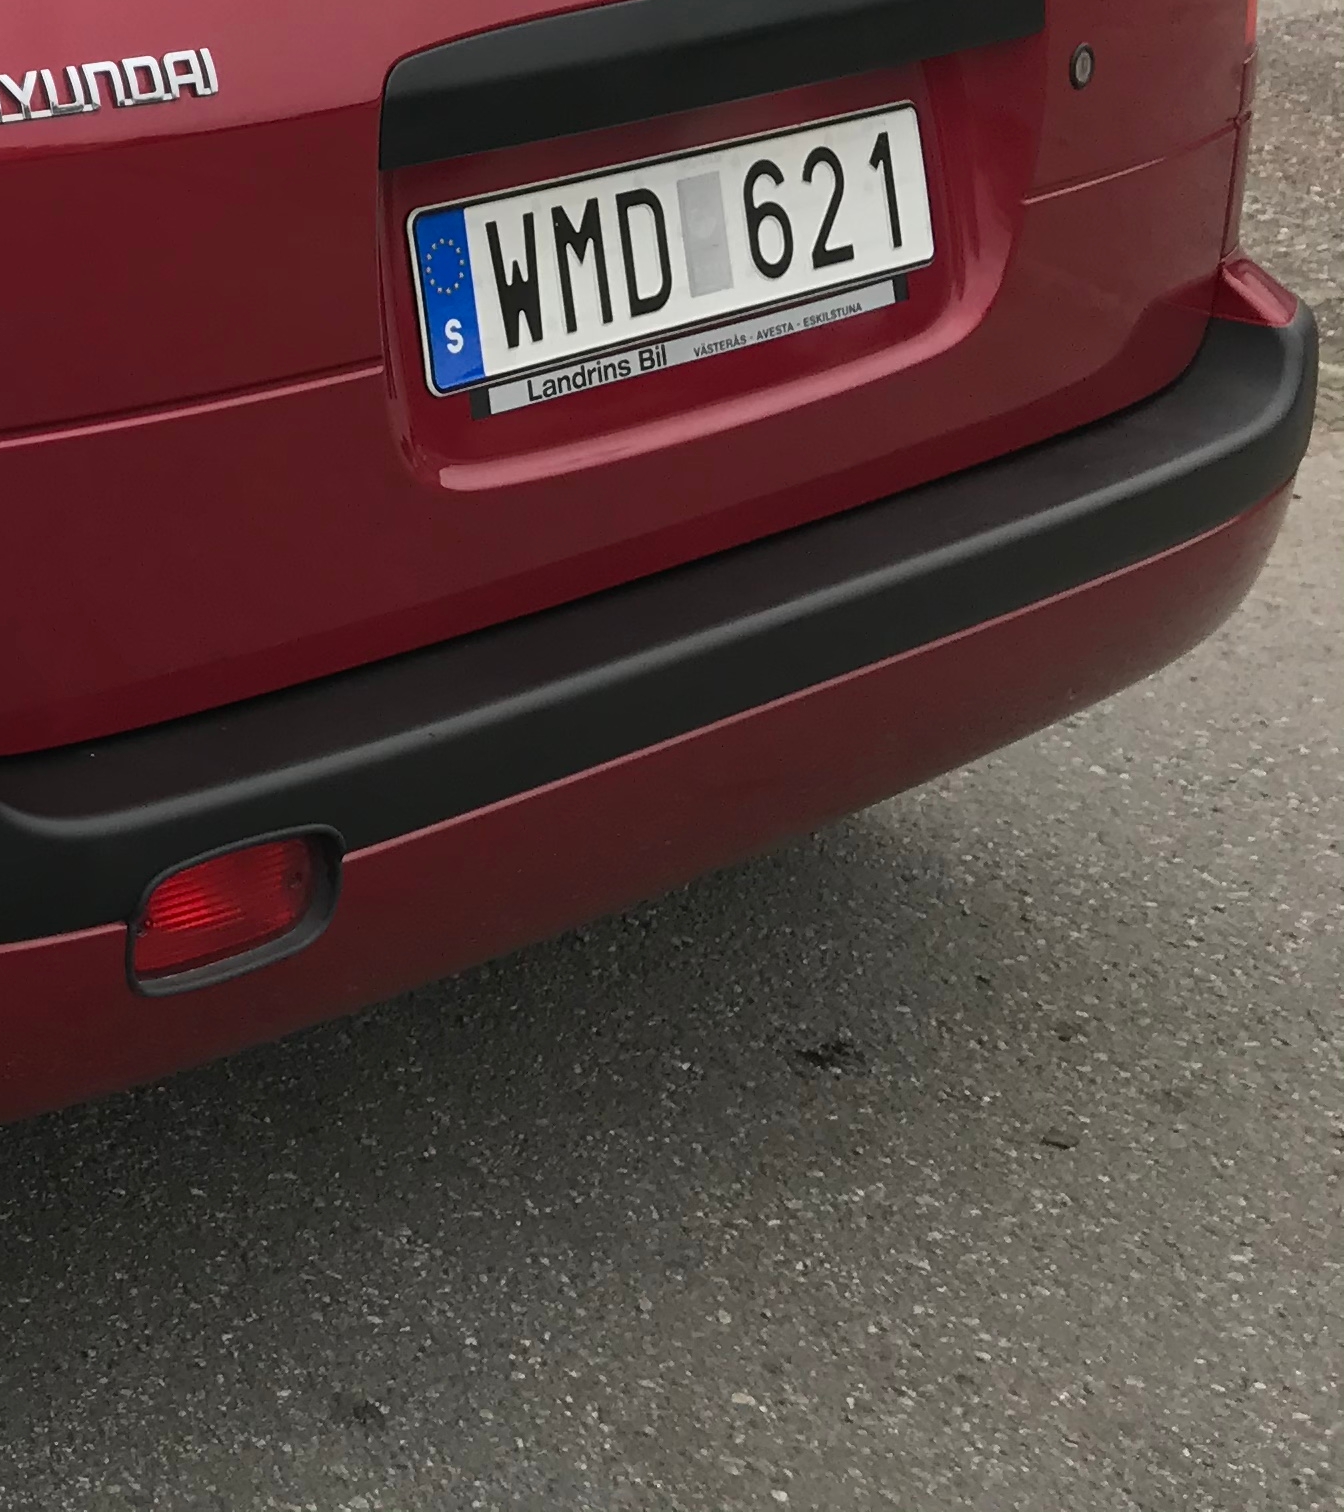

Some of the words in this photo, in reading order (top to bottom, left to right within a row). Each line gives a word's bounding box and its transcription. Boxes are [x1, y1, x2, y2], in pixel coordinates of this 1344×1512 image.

[444, 317, 465, 354] S
[486, 188, 672, 349] WMD
[742, 131, 904, 279] 621
[693, 333, 747, 358] VÄSTERÅS
[756, 321, 795, 341] AVESTA
[803, 302, 863, 328] ESKILSTUNA
[526, 358, 632, 402] Landrins
[638, 343, 668, 372] Bil
